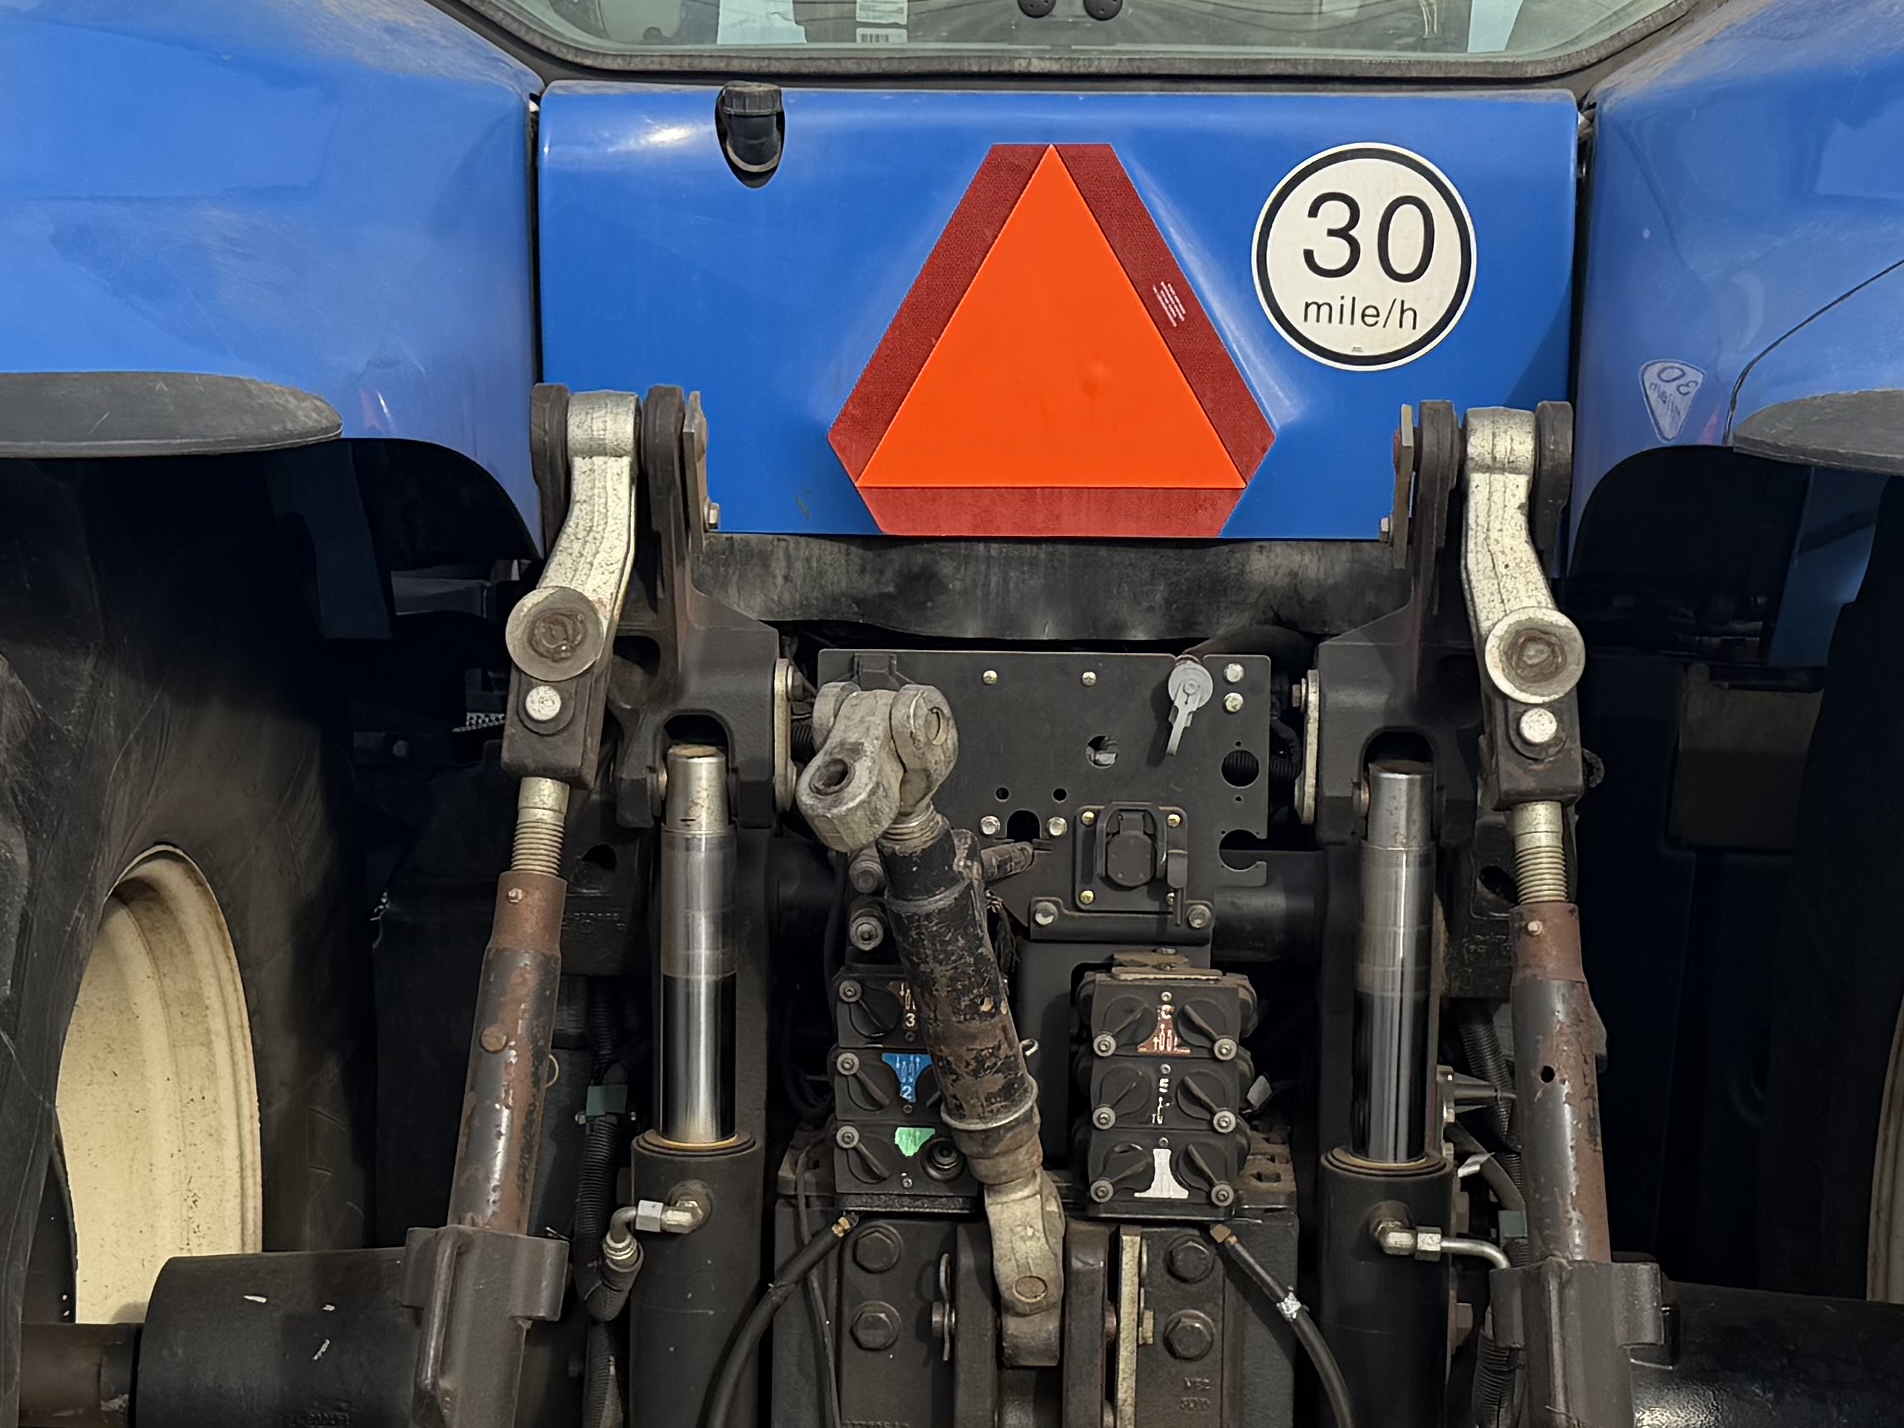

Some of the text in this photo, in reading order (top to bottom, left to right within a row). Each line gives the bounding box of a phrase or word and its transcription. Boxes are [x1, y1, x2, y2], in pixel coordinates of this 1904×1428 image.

[1302, 191, 1435, 283] 30
[1302, 294, 1418, 331] mile/h
[905, 1012, 916, 1027] 3
[901, 1085, 913, 1100] 2
